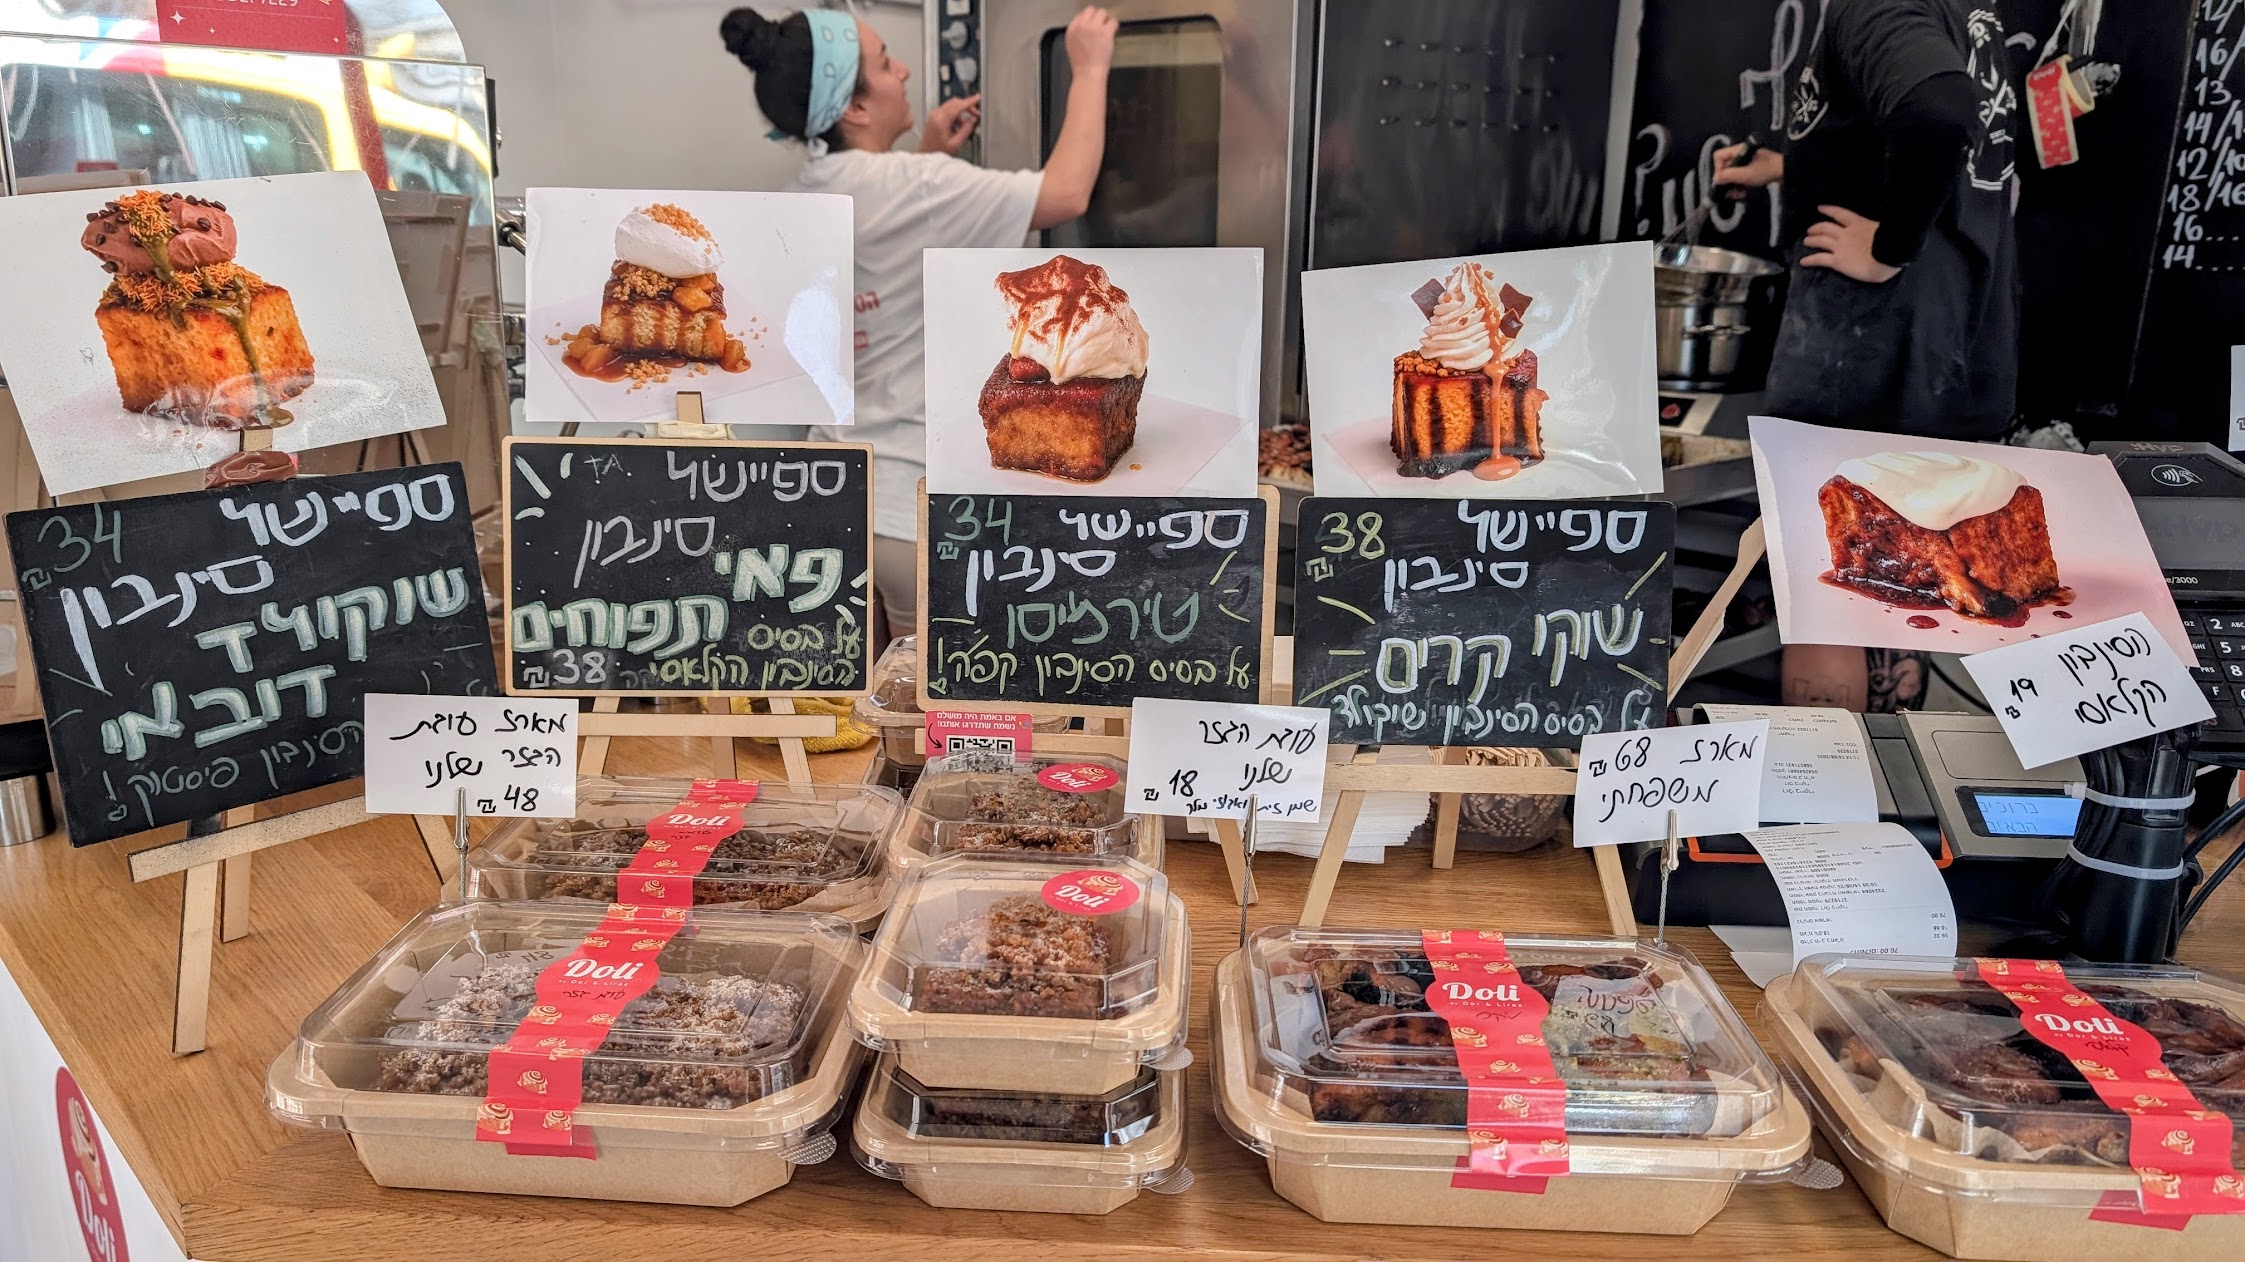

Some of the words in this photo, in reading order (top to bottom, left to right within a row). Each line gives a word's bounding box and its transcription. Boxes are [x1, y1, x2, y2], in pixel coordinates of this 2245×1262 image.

[2194, 77, 2231, 106] 13
[2184, 100, 2245, 150] 14/1
[667, 450, 846, 502] ספיישל
[219, 474, 454, 547] ספיישל
[945, 496, 1013, 546] 34
[1458, 499, 1648, 554] ספיישל
[38, 504, 122, 573] 34
[1059, 509, 1248, 549] ספיישל
[1321, 511, 1386, 559] 38
[574, 515, 715, 589] סינבון
[714, 543, 843, 613] פאי
[965, 545, 1116, 617] סינבון
[1384, 555, 1530, 613] סינבון
[2165, 575, 2199, 585] e/3000
[60, 555, 274, 691] סינבון
[195, 567, 469, 673] שוקולד
[510, 595, 729, 660] תפוחים
[749, 623, 824, 650] בסיס
[1007, 591, 1199, 649] טירמיסו
[2210, 618, 2223, 630] 2
[1532, 603, 1644, 687] שוקו
[2057, 627, 2151, 687] הסינבון
[2220, 641, 2232, 653] 5
[552, 649, 606, 684] 38
[649, 643, 749, 690] הקלאסי
[760, 658, 855, 690] הסינבון
[1035, 653, 1135, 696] הסינבון
[1149, 659, 1217, 685] בסיס
[1226, 646, 1250, 690] על
[1375, 634, 1512, 702] קרים
[2230, 665, 2242, 677] 8
[2010, 678, 2039, 703] 19
[2074, 677, 2167, 729] הקלאסי
[101, 664, 337, 761] דובאי
[389, 711, 477, 740] עוגת
[494, 708, 568, 734] מארז
[936, 711, 962, 719] מושלם
[980, 713, 1003, 721] באמת
[1331, 684, 1427, 743] שוקולד
[1443, 701, 1538, 745] הסינבון
[1544, 704, 1603, 736] בסיס
[1198, 720, 1250, 745] הגזר
[1255, 721, 1319, 755] עוגת
[1679, 733, 1759, 765] מארז
[425, 751, 483, 788] שלנו
[501, 746, 561, 768] הגזר
[1615, 736, 1652, 772] 68
[1050, 771, 1091, 789] Doli
[1169, 769, 1199, 797] 18
[1239, 756, 1293, 792] שלנו
[503, 784, 539, 812] 48
[1598, 777, 1719, 823] משפחתי
[668, 813, 731, 826] Doli
[1055, 885, 1111, 908] Doli
[563, 958, 644, 980] Doli
[1442, 982, 1521, 1002] Doli
[2035, 1013, 2124, 1035] Doli
[75, 1169, 117, 1262] Doli
